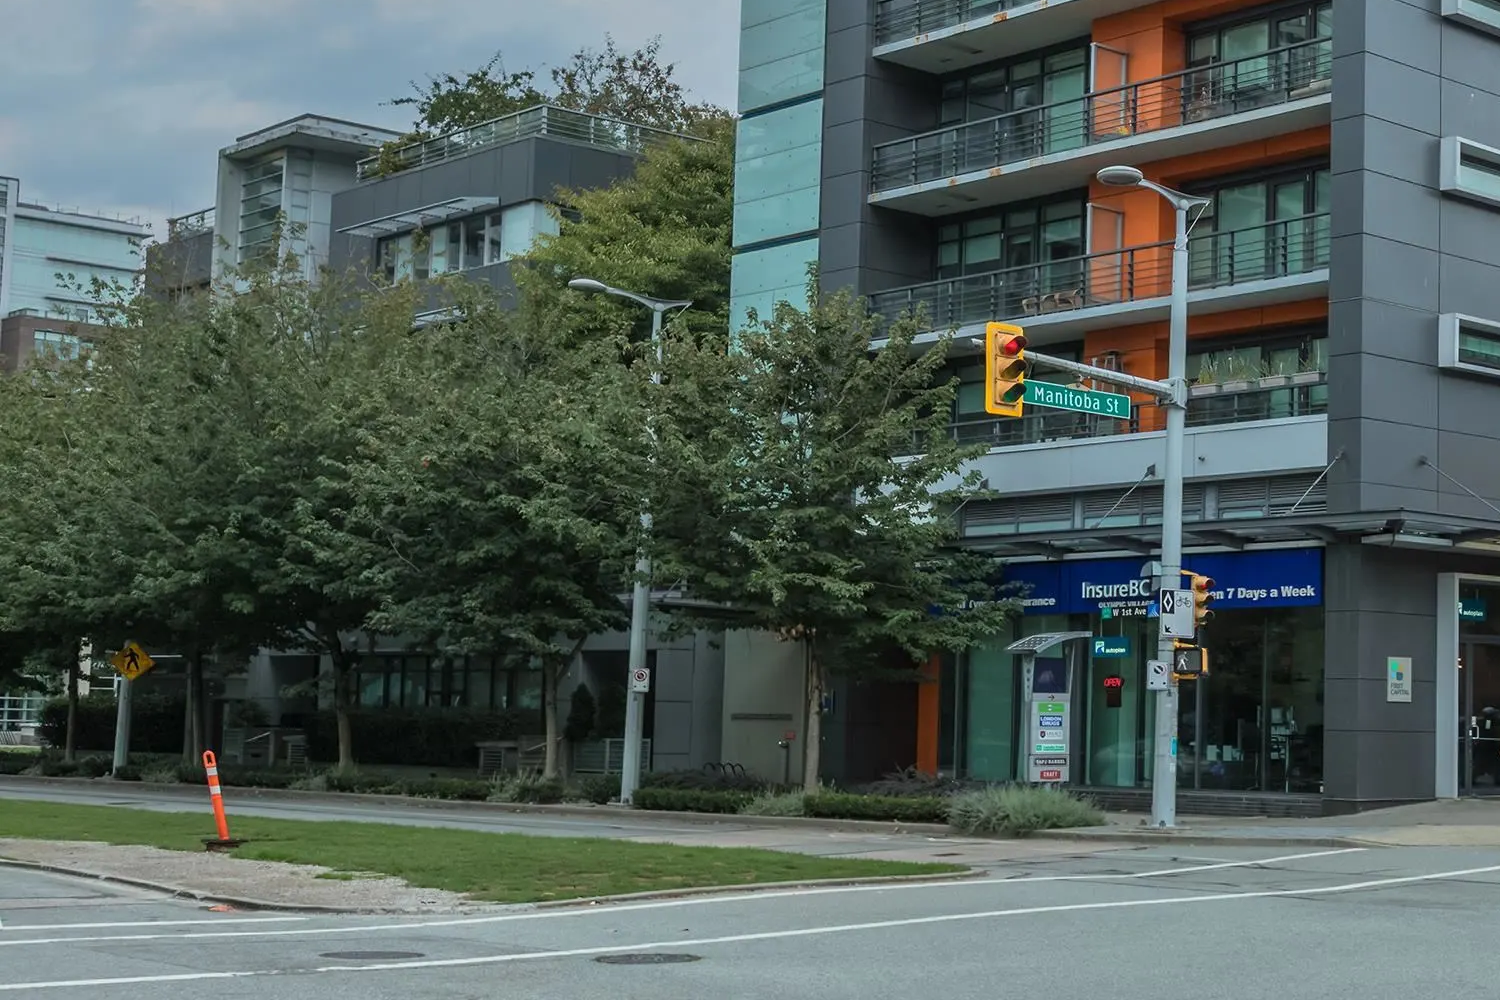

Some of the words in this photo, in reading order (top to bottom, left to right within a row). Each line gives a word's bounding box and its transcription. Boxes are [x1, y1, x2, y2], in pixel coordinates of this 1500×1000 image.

[1034, 386, 1100, 411] Manitoba
[1106, 398, 1119, 414] St
[1081, 579, 1150, 599] InsureBC
[1226, 587, 1235, 599] 7
[1237, 587, 1267, 601] Days
[1269, 588, 1279, 598] a
[1280, 584, 1315, 597] Week
[1112, 608, 1119, 616] W
[1121, 607, 1133, 616] 1st
[1134, 607, 1147, 616] Ave
[1105, 647, 1126, 655] autoplan
[1103, 677, 1122, 687] OPEN
